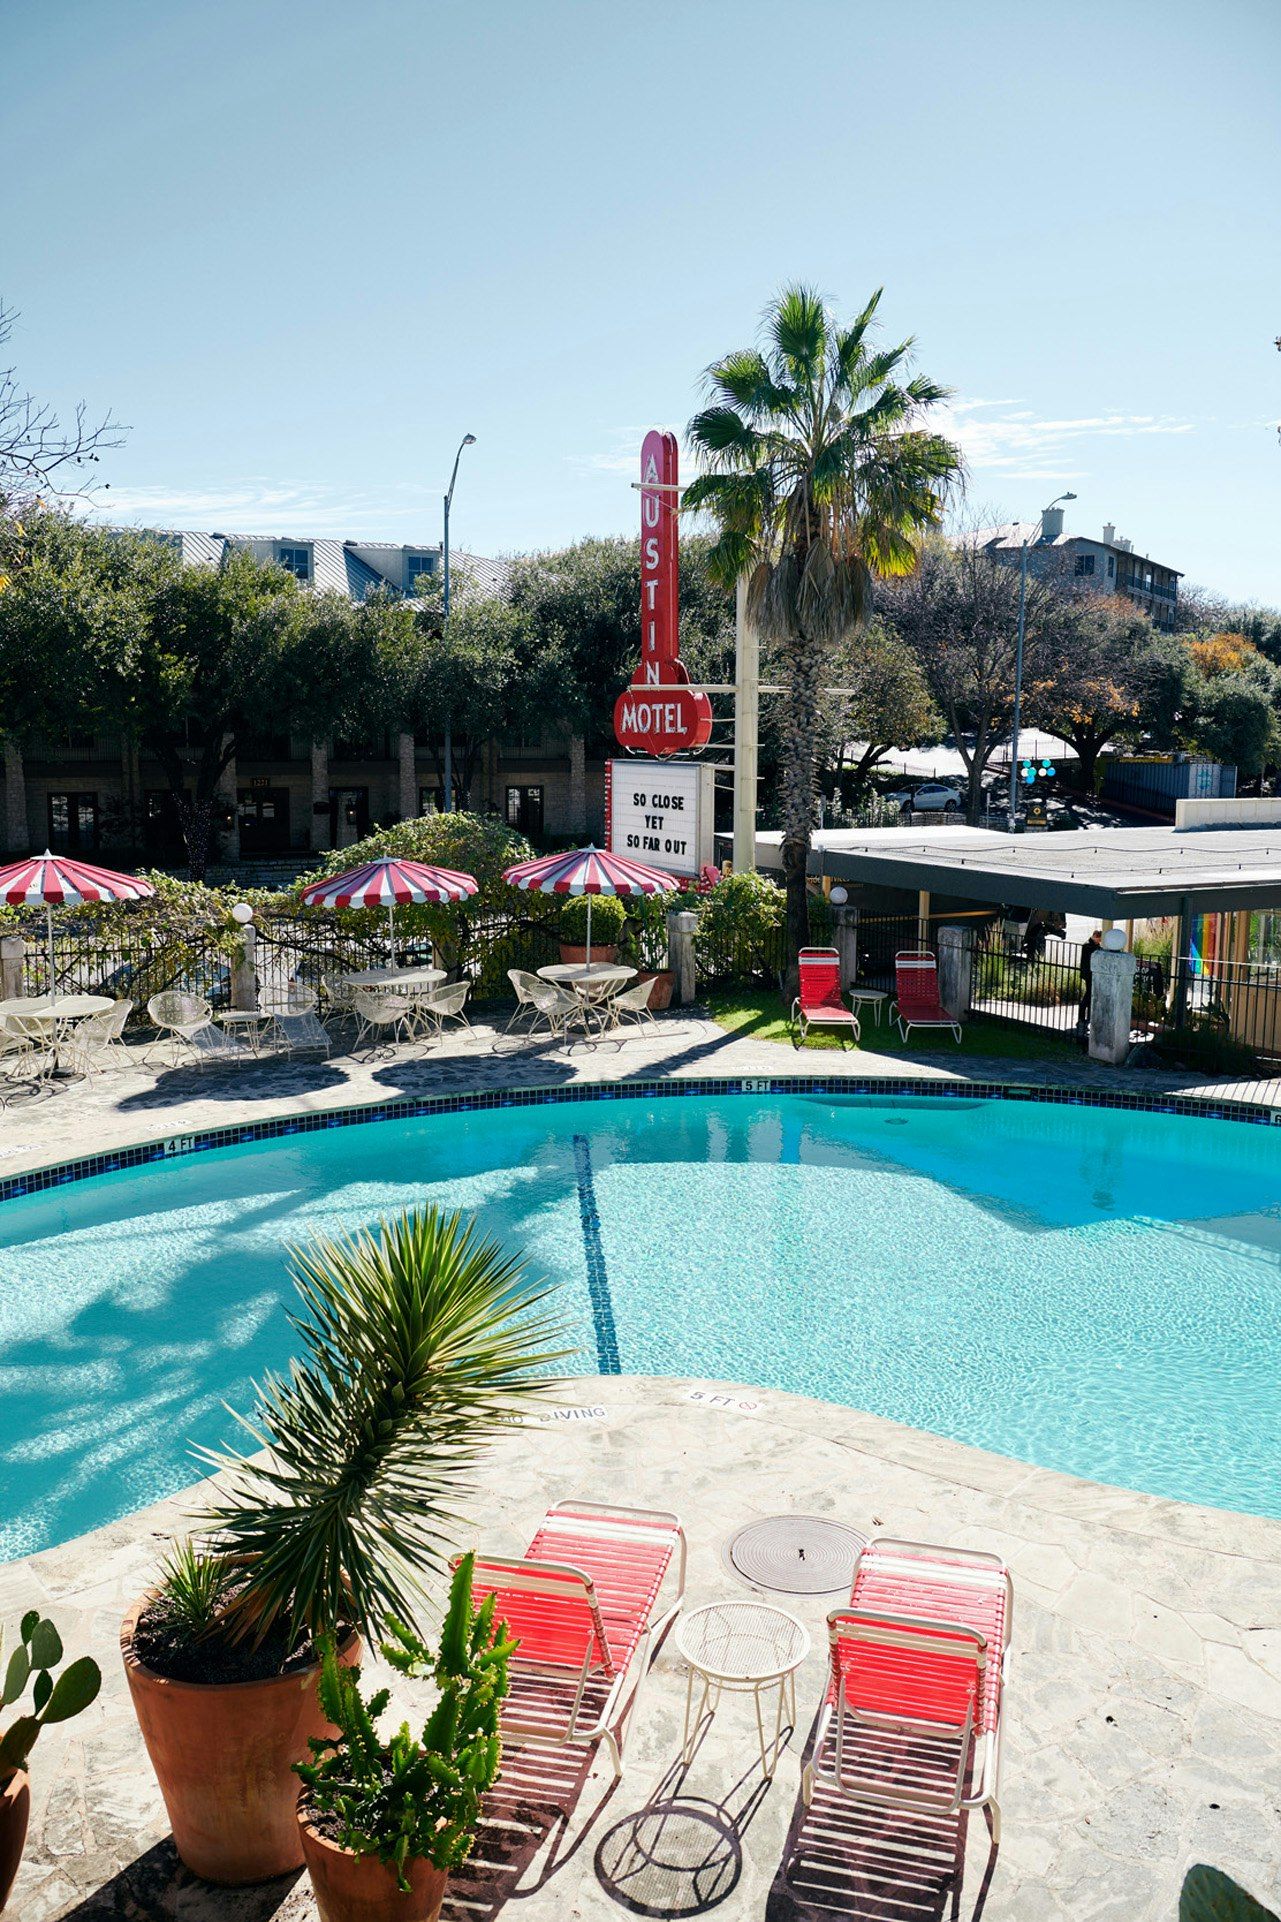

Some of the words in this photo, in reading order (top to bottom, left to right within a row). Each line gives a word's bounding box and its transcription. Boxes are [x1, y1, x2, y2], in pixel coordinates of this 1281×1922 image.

[644, 453, 660, 690] AUSTIN
[621, 703, 688, 734] MOTEL
[633, 793, 646, 806] SO
[652, 794, 684, 810] CLOSE
[645, 815, 664, 830] YET
[627, 834, 640, 848] SO
[643, 836, 661, 851] FAR
[665, 839, 687, 855] OUT
[745, 1081, 753, 1091] 5
[757, 1081, 769, 1091] FT
[168, 1140, 176, 1151] 4
[180, 1136, 193, 1150] FT
[690, 1391, 705, 1400] 5
[708, 1394, 735, 1407] FT
